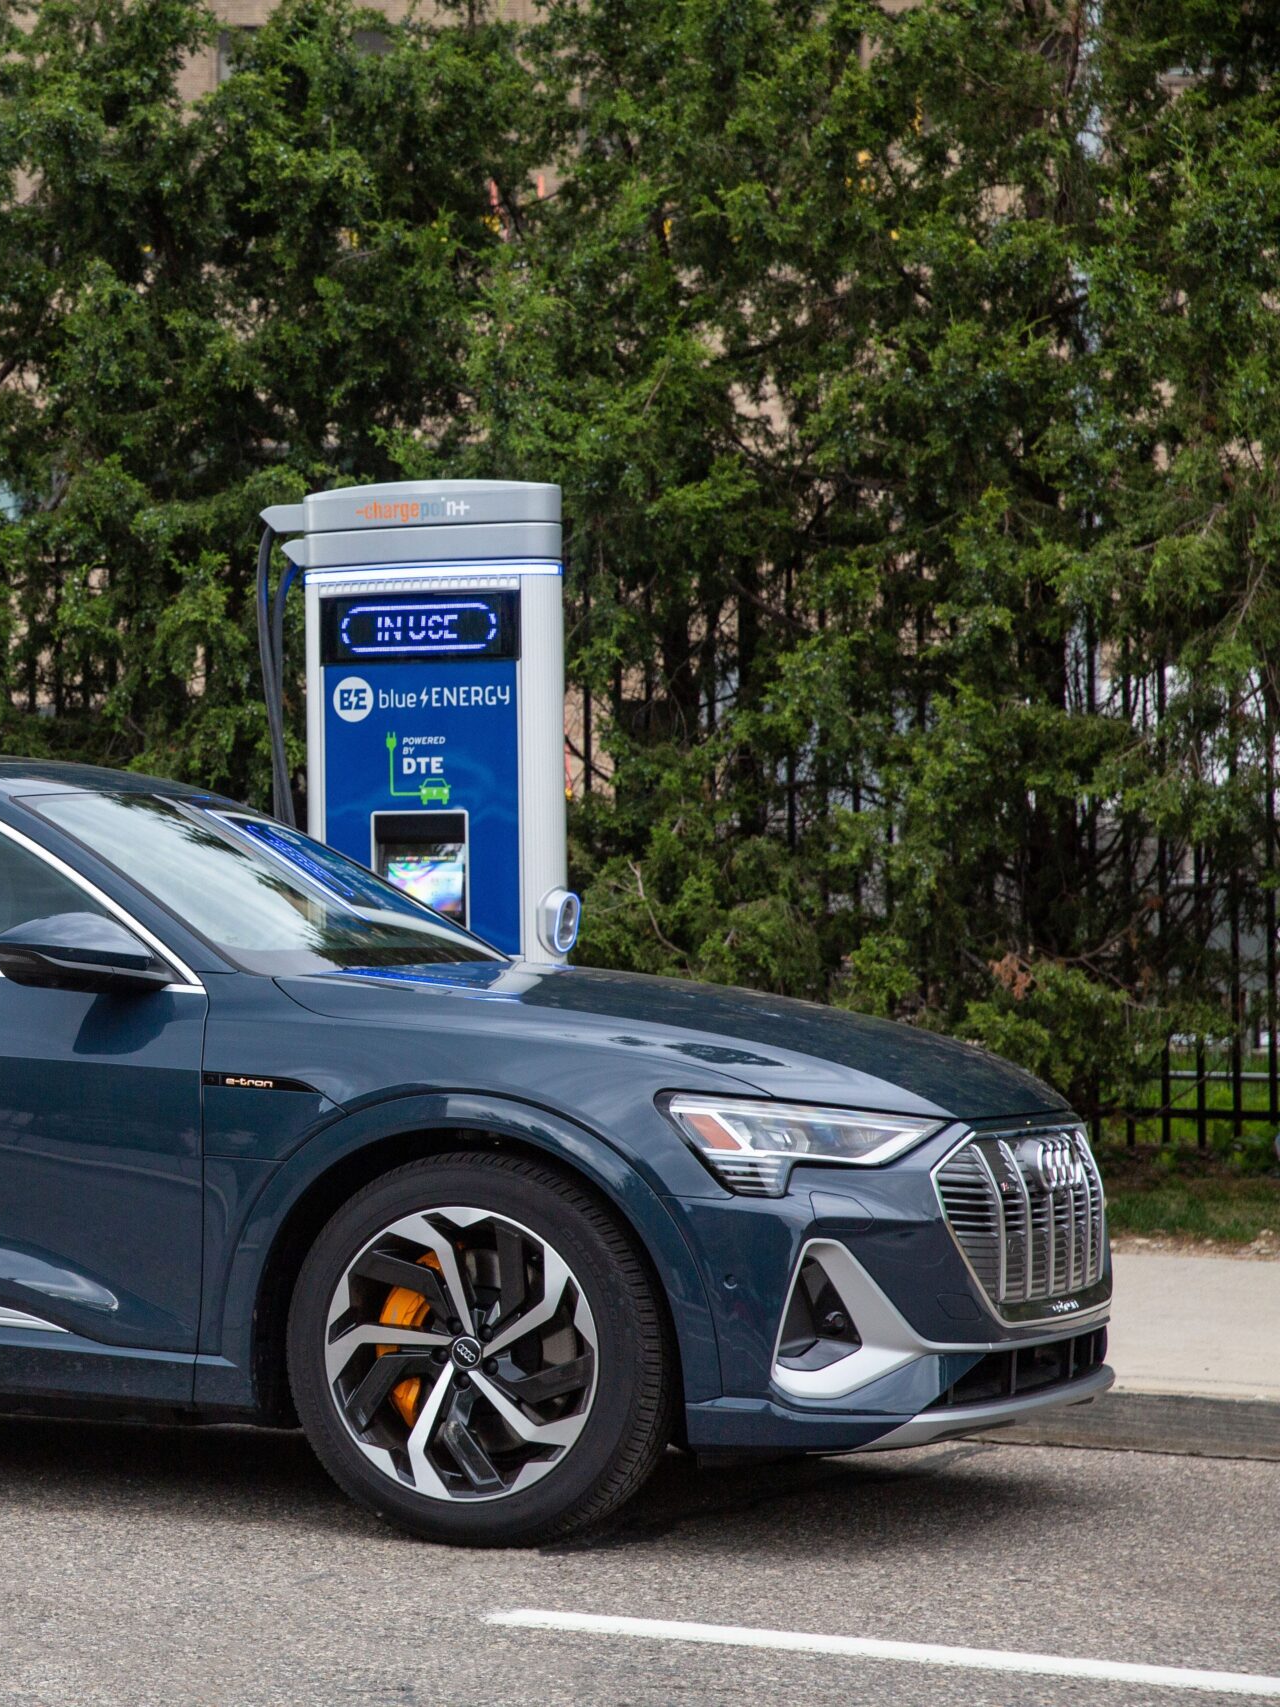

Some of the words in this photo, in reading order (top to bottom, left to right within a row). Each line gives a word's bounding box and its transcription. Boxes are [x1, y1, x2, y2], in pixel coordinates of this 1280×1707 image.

[377, 616, 402, 641] IN
[408, 614, 458, 640] USE
[378, 688, 417, 709] blue
[431, 685, 511, 707] ENERGY
[402, 736, 446, 745] POWERED
[402, 746, 415, 755] BY
[402, 756, 444, 775] DTE
[225, 1077, 273, 1088] e-tron
